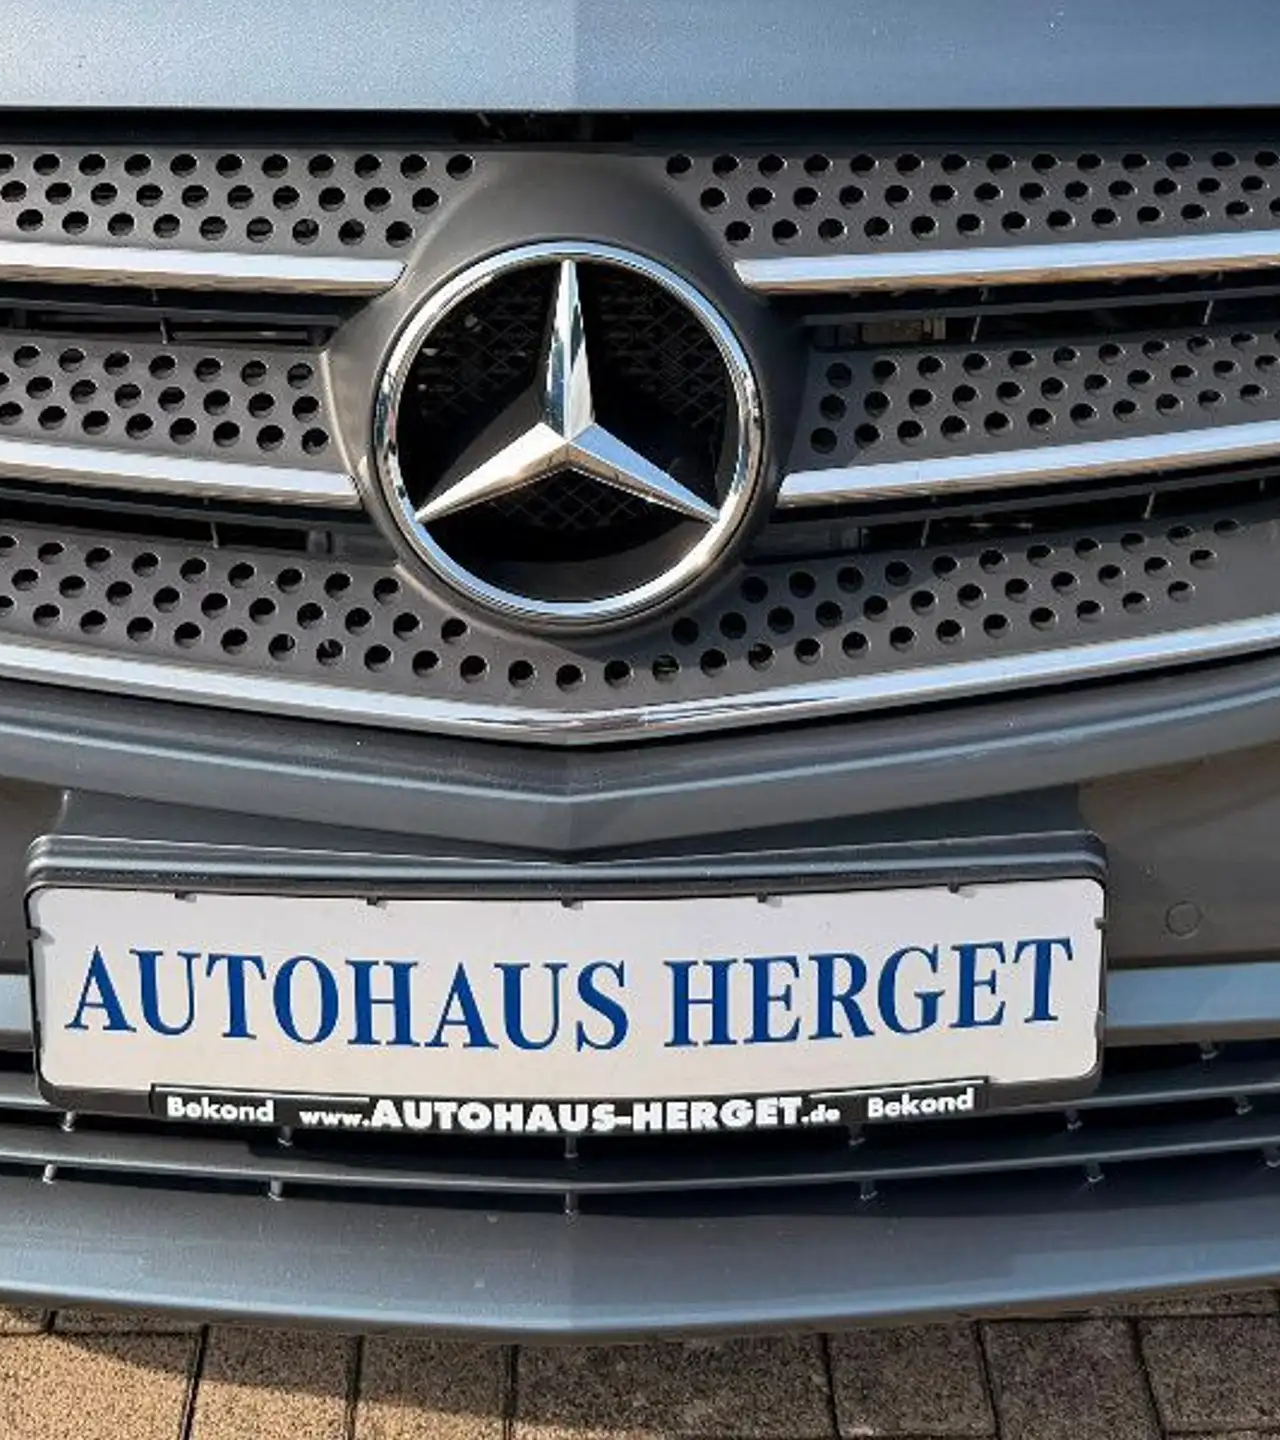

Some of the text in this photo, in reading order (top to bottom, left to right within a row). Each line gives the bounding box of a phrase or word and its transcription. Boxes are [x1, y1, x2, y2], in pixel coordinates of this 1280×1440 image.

[64, 937, 1075, 1051] AUTOHAUS HERGET
[166, 1088, 975, 1133] Bekond www.AUTOHAUS-HERGET.de Bekond
